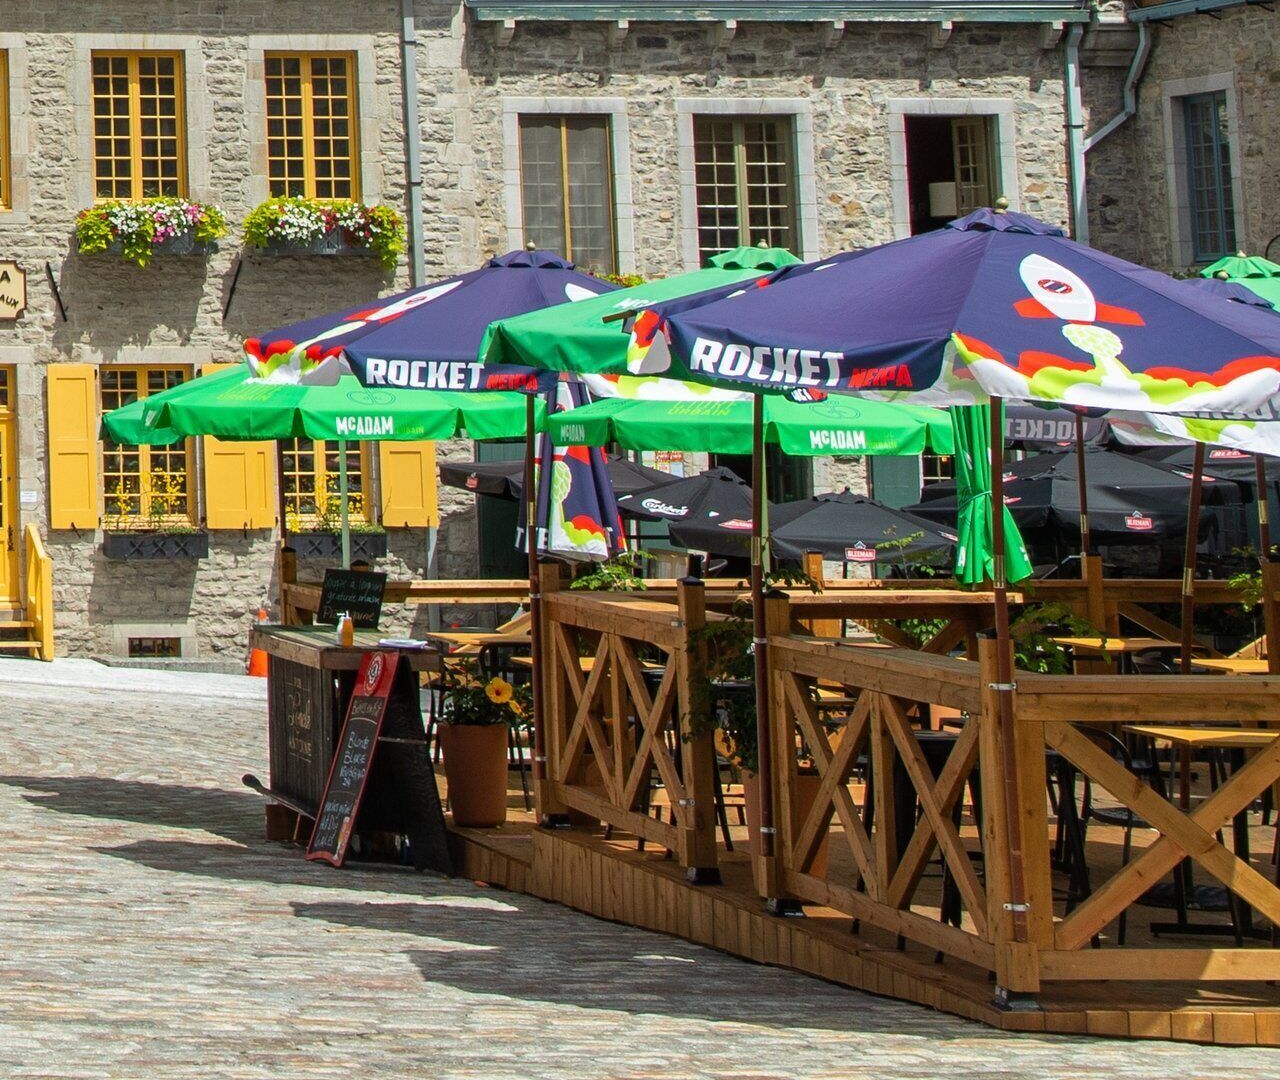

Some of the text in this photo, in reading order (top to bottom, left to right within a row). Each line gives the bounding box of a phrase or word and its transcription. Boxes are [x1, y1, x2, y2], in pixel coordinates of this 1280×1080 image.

[366, 357, 538, 391] ROCKET NEIPA
[690, 336, 913, 389] ROCKET NEIPA
[641, 498, 690, 516] Carlsberg
[847, 550, 874, 558] SLEEMAN
